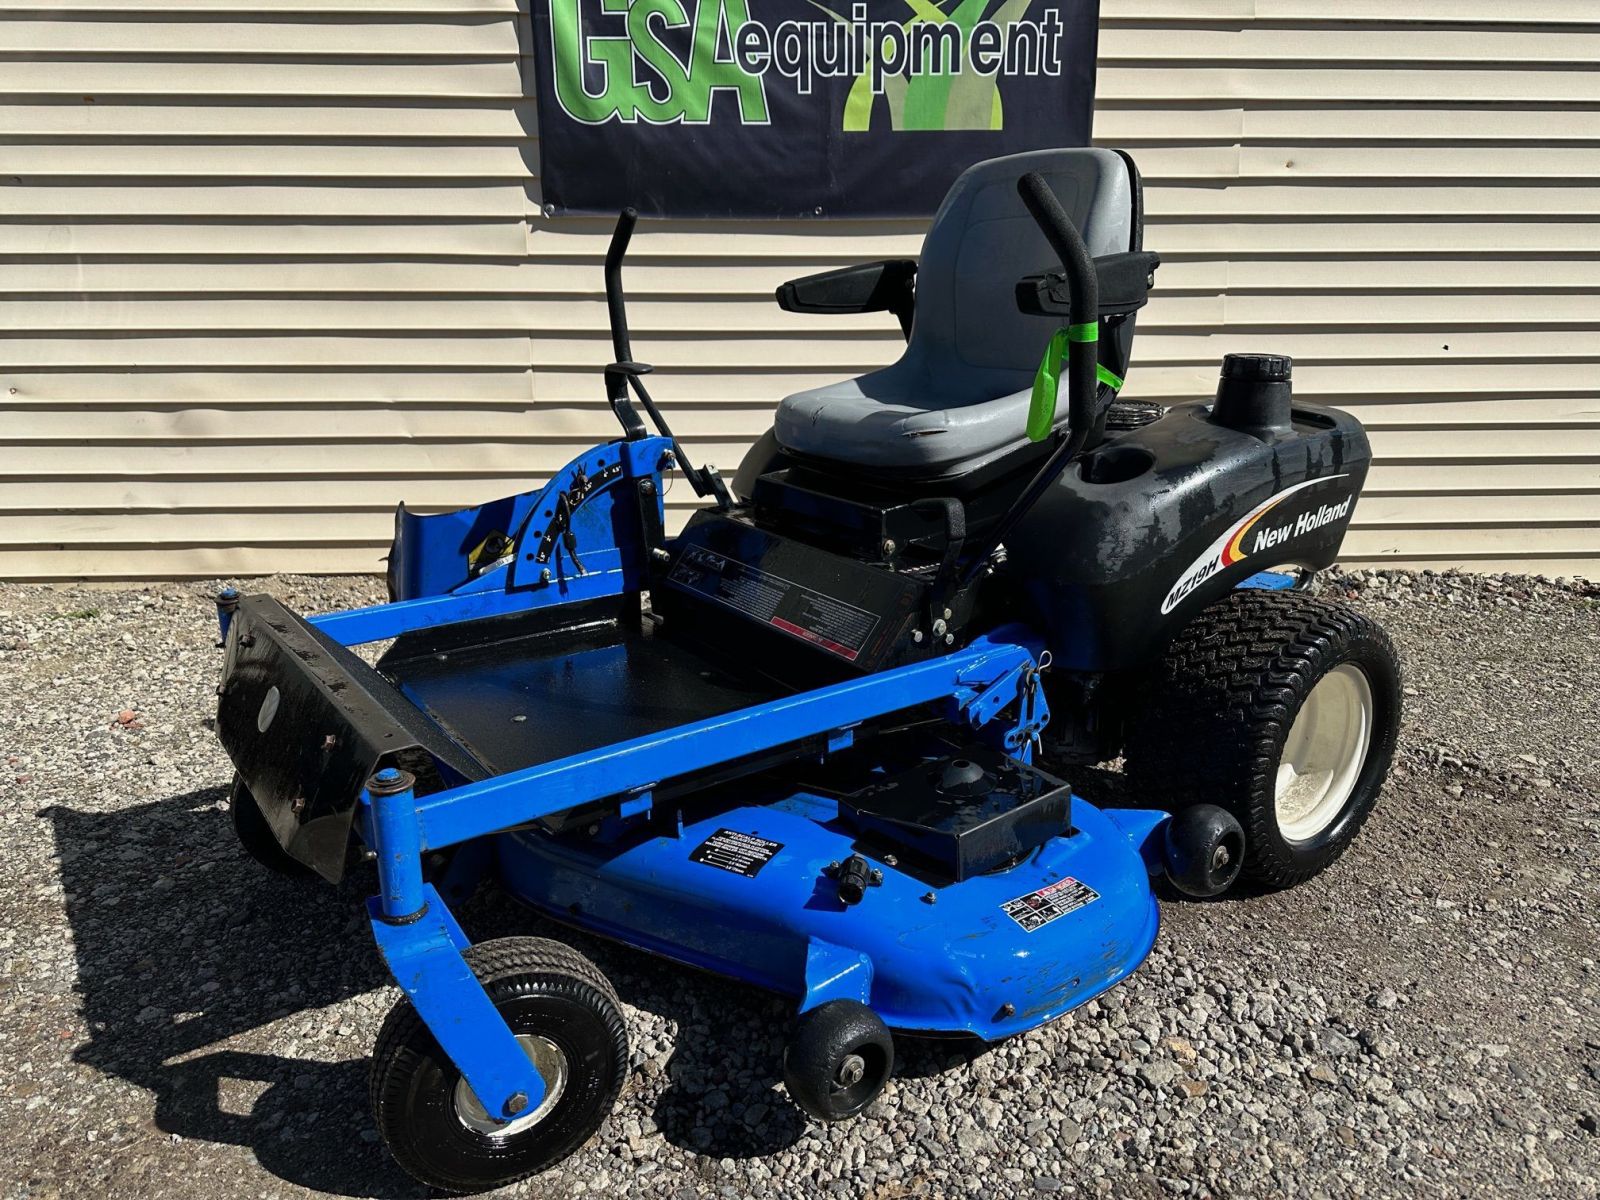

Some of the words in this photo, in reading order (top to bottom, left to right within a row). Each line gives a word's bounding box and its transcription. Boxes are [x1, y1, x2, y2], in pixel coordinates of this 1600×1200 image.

[548, 0, 771, 125] GSA
[735, 3, 1064, 94] equipment
[1252, 523, 1294, 553] New
[1293, 494, 1353, 537] Holland
[1165, 554, 1220, 610] MZ19H
